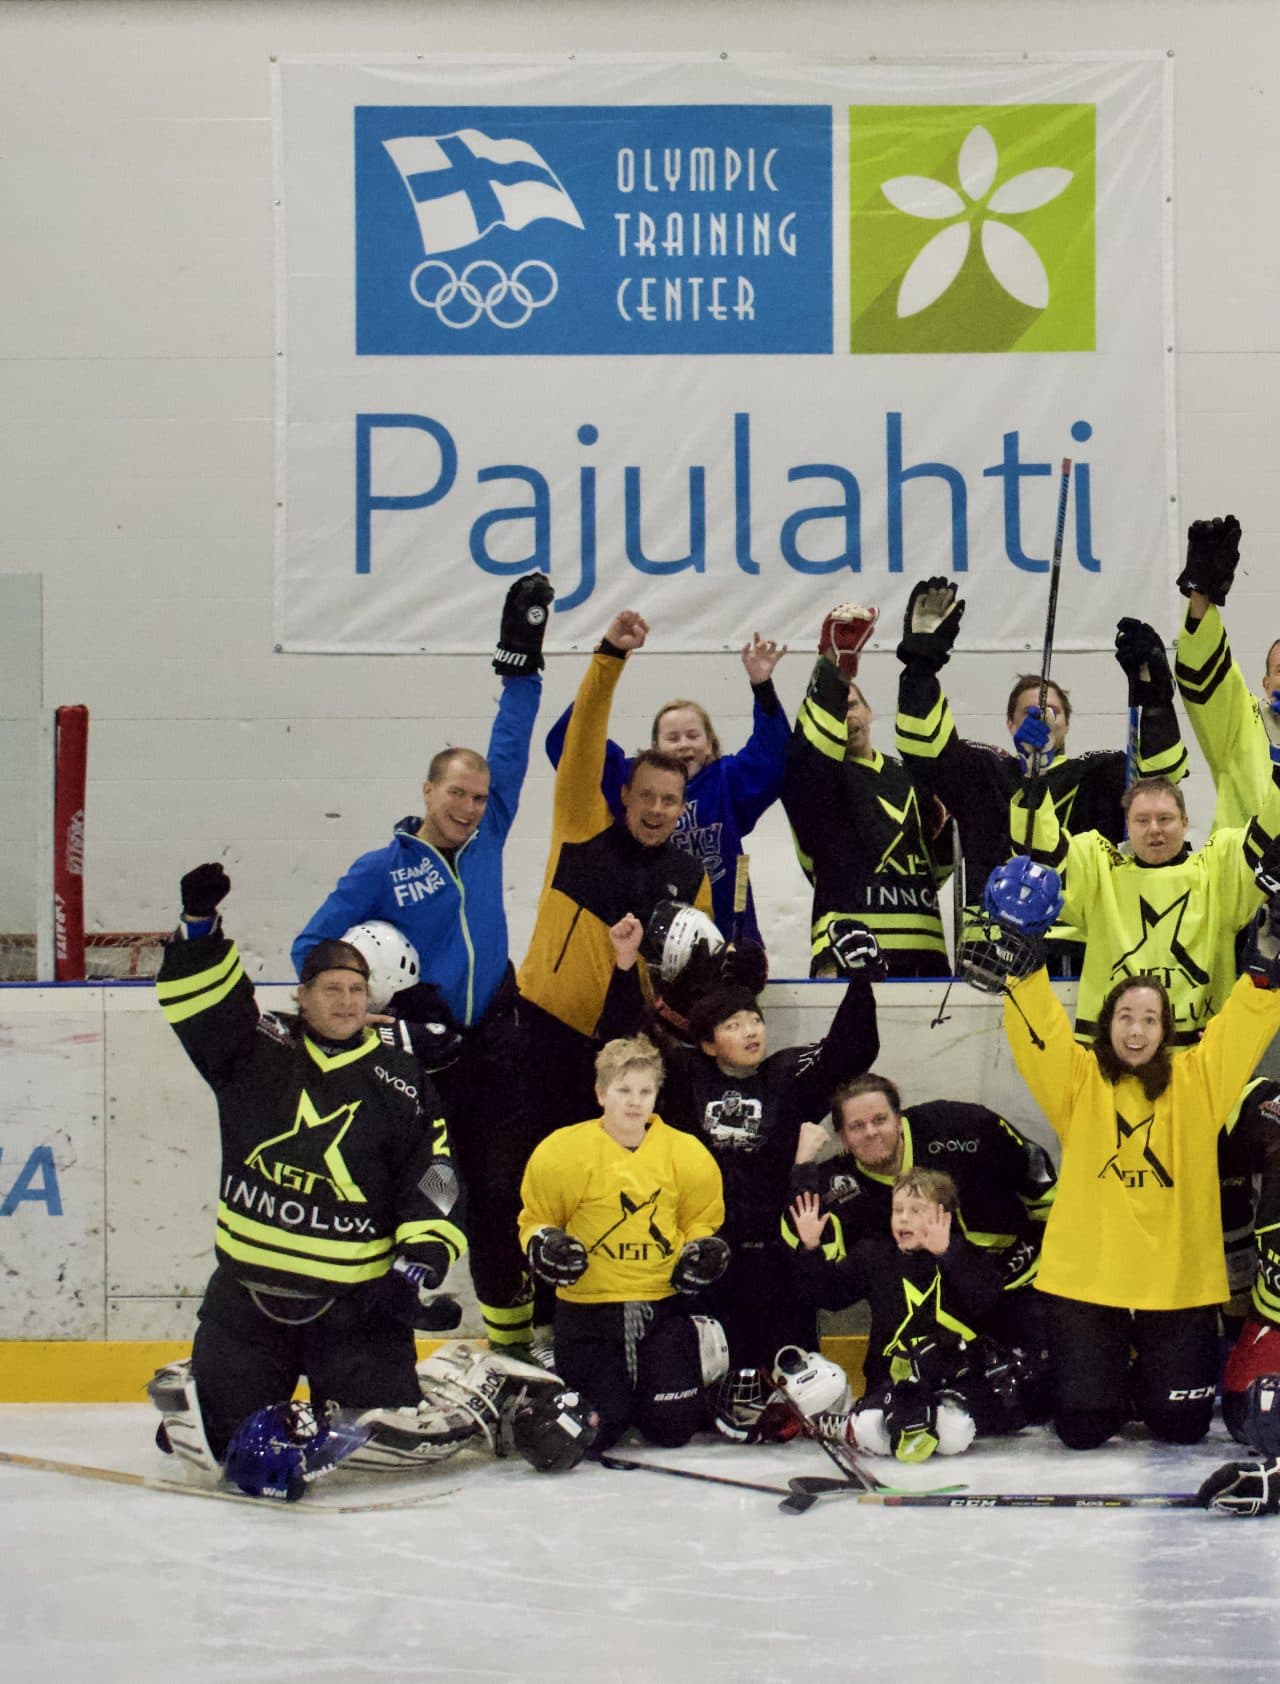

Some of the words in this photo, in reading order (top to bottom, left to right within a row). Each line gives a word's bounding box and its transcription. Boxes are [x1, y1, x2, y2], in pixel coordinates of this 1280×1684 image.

[618, 147, 780, 193] OLYMPIC
[614, 212, 798, 258] TRAINING
[616, 276, 756, 322] CENTER
[355, 412, 1102, 613] Pajulahti
[389, 865, 427, 883] TEAM
[393, 878, 434, 907] FIN
[866, 885, 932, 908] INNO
[432, 1117, 452, 1158] 2
[0, 1145, 64, 1217] A
[224, 1174, 377, 1234] INNOLUX
[653, 1387, 699, 1402] BAUER
[1168, 1384, 1216, 1401] CCM
[949, 1498, 997, 1509] CCM
